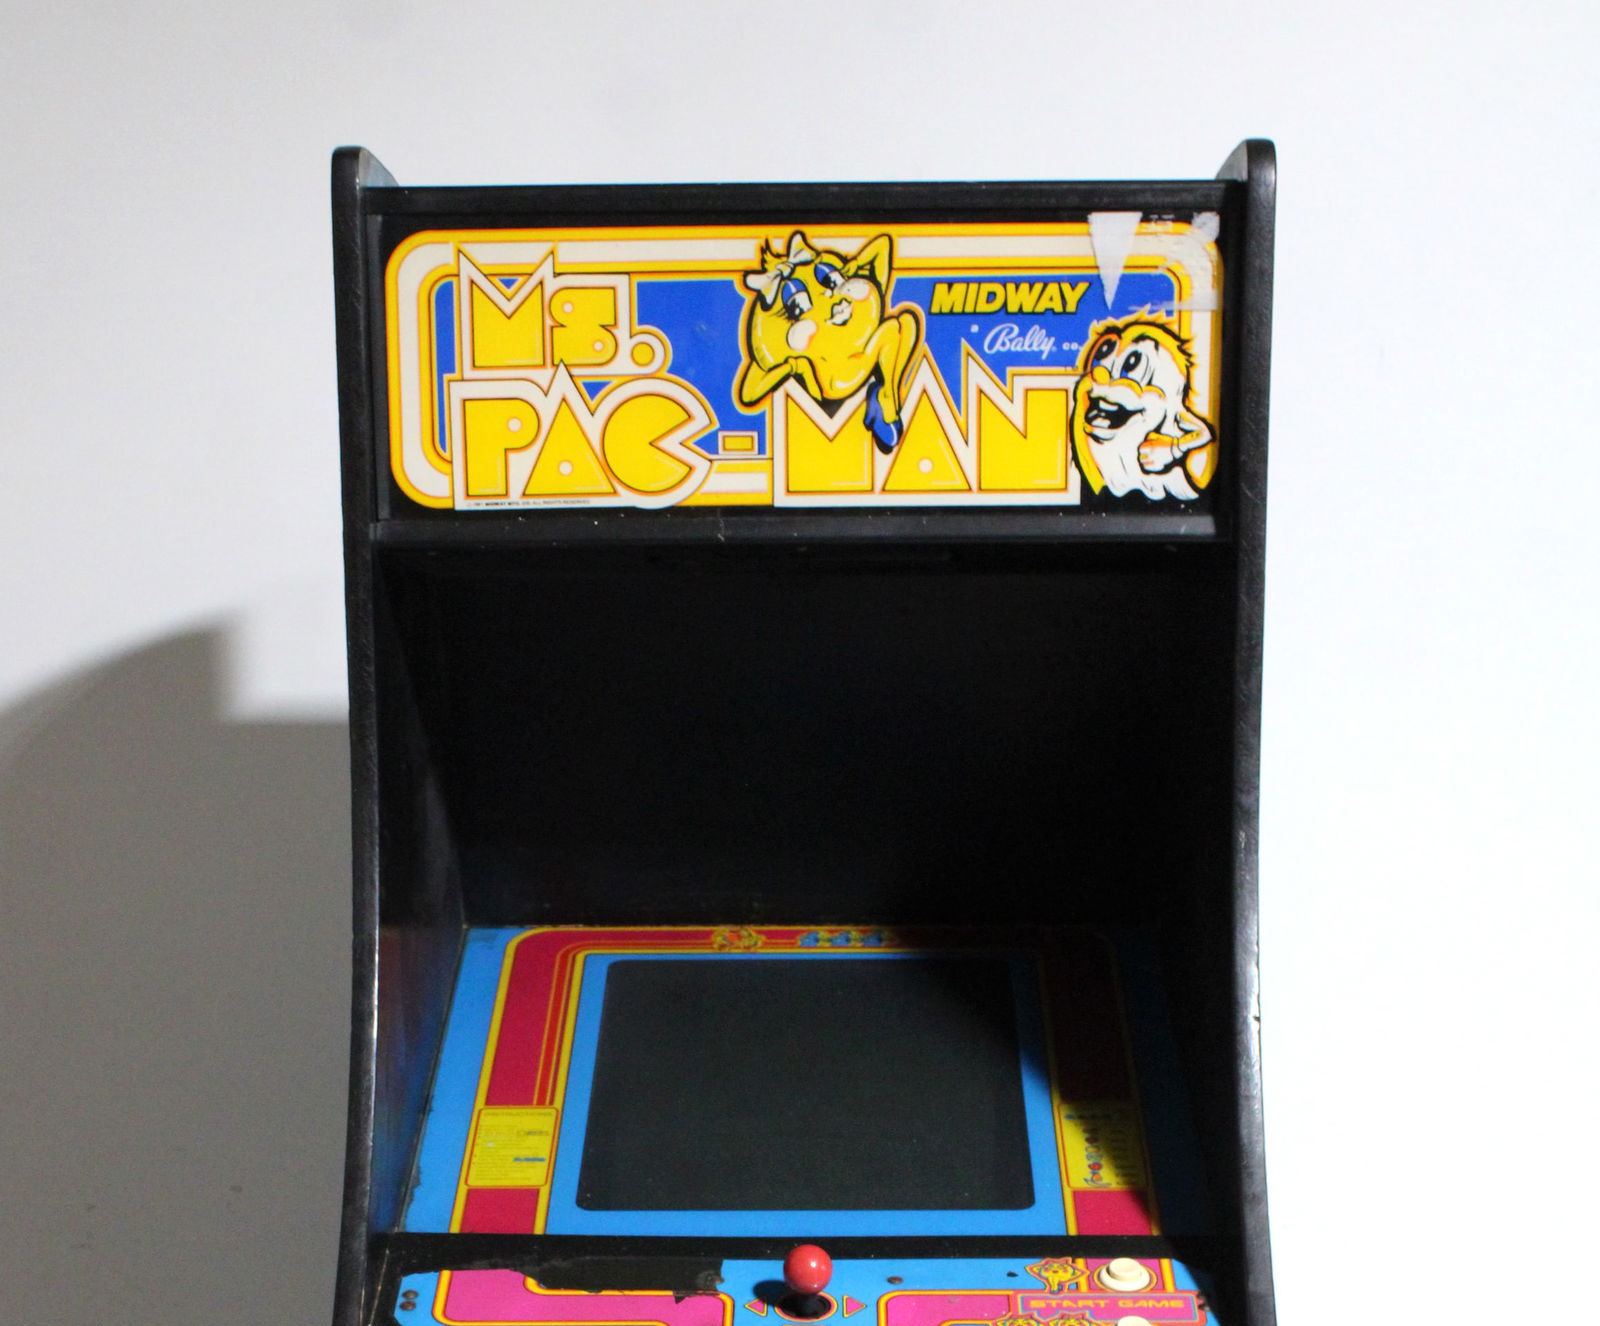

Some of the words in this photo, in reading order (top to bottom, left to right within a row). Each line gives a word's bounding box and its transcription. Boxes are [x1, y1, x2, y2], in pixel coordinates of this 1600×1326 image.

[929, 281, 1091, 315] MIDWAY
[983, 323, 1056, 360] Bally
[451, 352, 1076, 503] PAC-MAN
[1030, 1299, 1109, 1308] START
[1118, 1299, 1184, 1309] GAME
